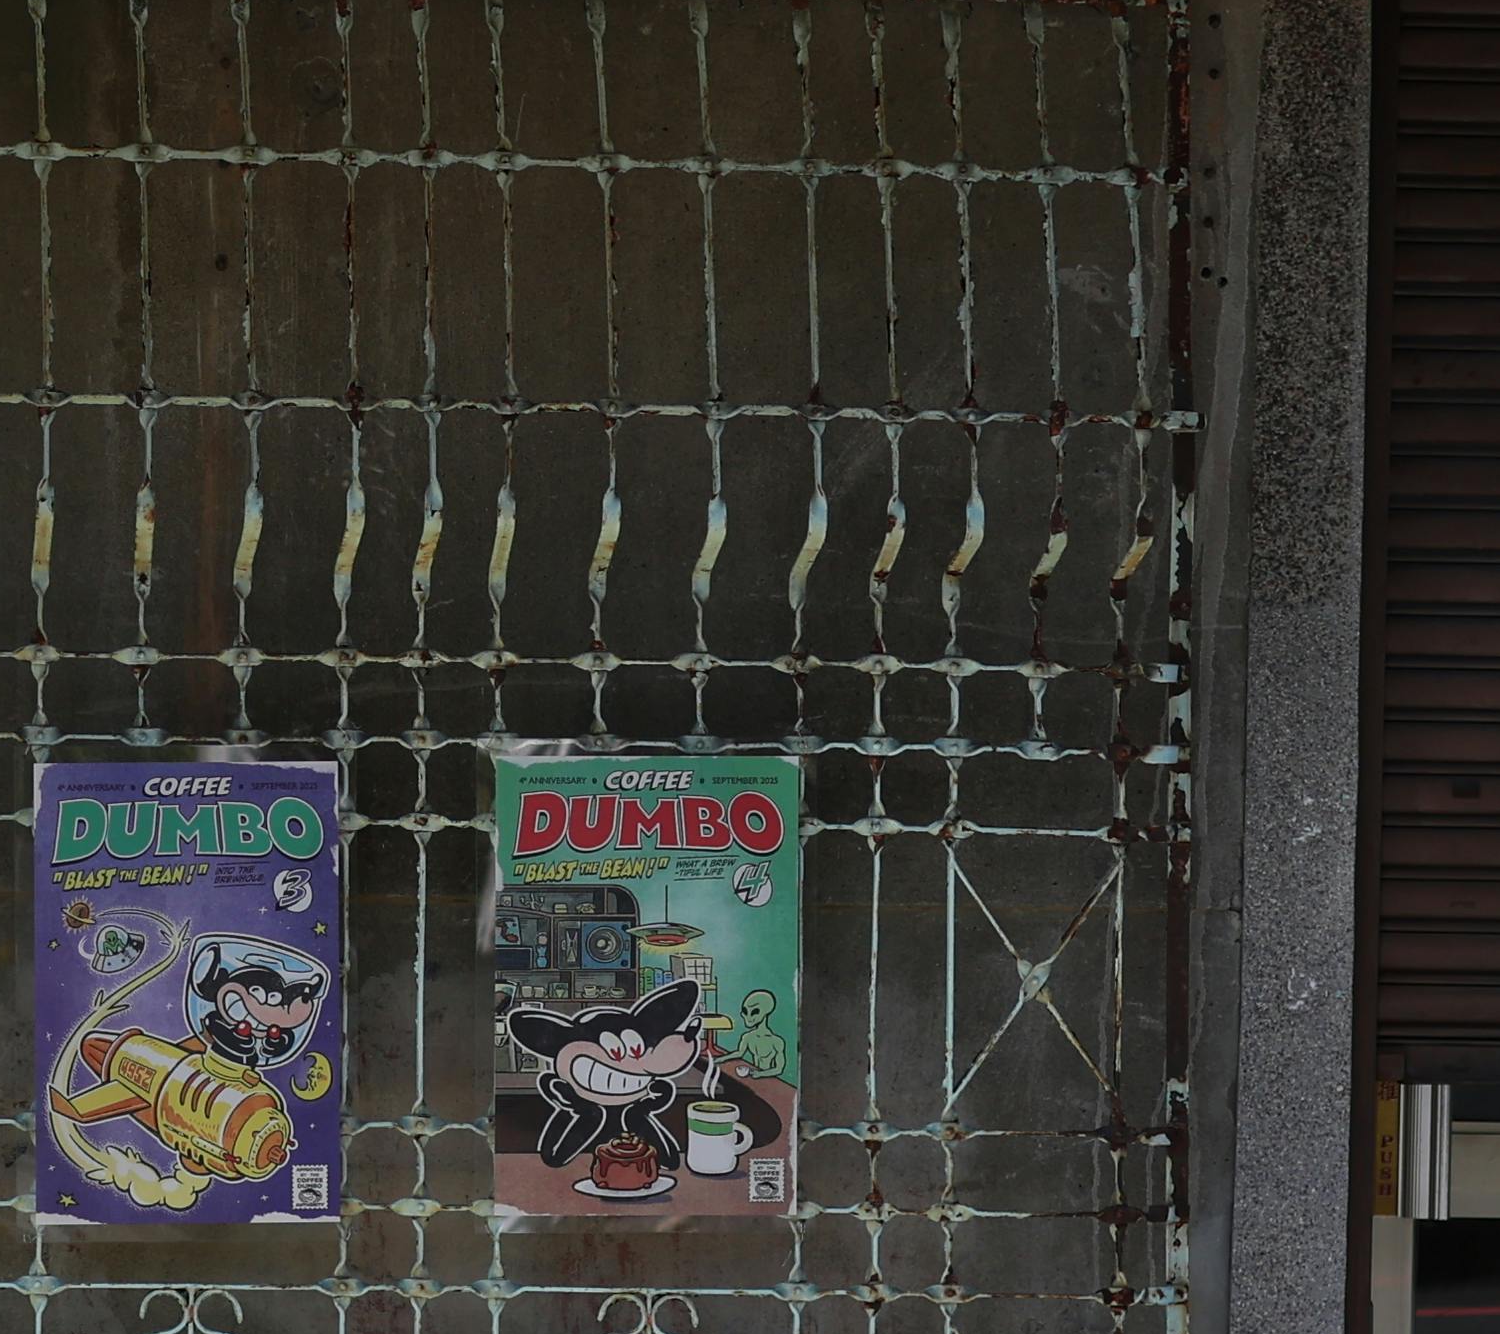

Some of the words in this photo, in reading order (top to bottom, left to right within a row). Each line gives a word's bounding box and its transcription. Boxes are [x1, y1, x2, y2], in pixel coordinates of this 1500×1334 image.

[143, 775, 232, 798] COFFEE
[251, 782, 297, 790] SEPTEMBER
[604, 769, 694, 791] COFFEE
[712, 776, 759, 785] SEPTEMBER
[51, 796, 325, 865] DUMBO
[512, 791, 785, 858] DUMBO
[215, 867, 235, 875] INTO
[239, 866, 255, 874] THE
[579, 863, 598, 875] THE
[675, 860, 697, 869] WHAT
[701, 860, 708, 868] A
[709, 858, 736, 867] BREW
[705, 867, 724, 876] LIFE
[119, 869, 138, 881] THE
[736, 861, 771, 904] 4
[275, 868, 312, 911] 3
[1378, 1080, 1398, 1100] 推
[1379, 1134, 1393, 1195] PUSH
